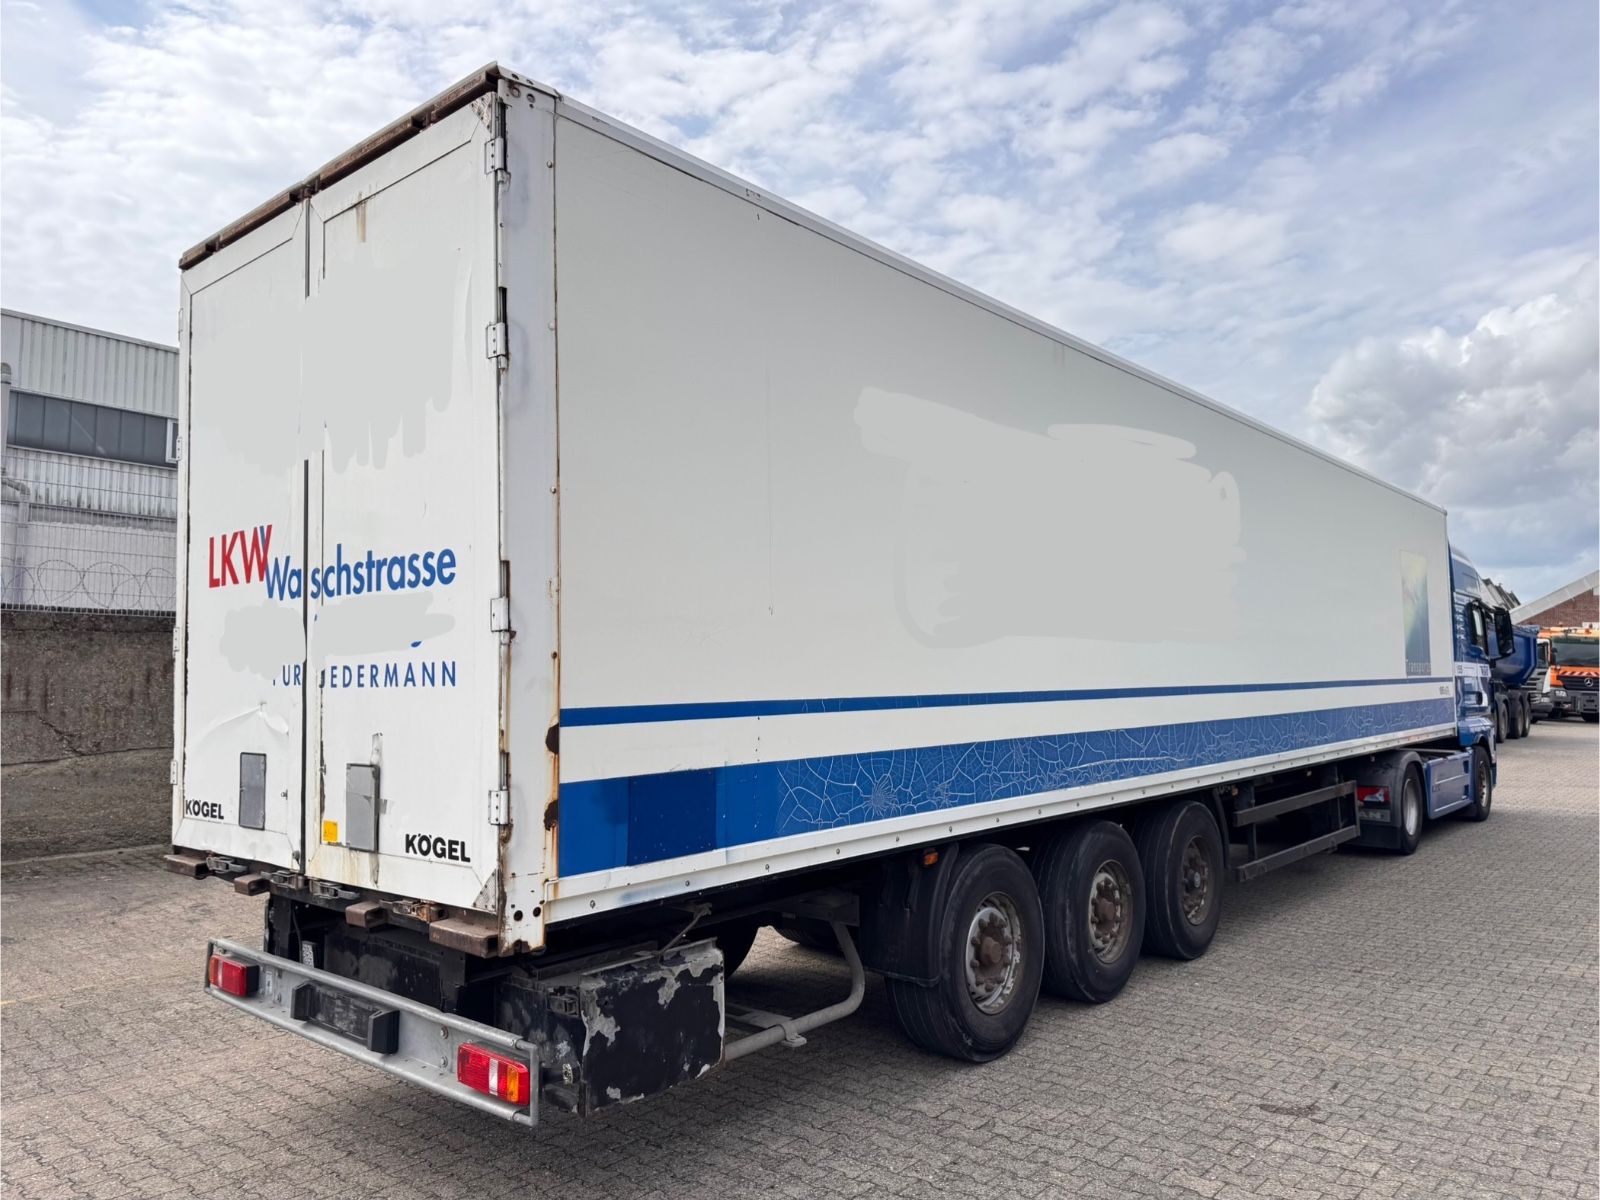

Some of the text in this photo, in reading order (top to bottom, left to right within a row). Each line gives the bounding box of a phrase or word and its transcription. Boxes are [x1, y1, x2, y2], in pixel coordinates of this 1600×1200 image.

[208, 524, 457, 601] LKW Waschstrasse
[318, 660, 457, 689] JEDERMANN
[185, 798, 225, 820] KÖGEL
[1359, 809, 1381, 819] AN
[405, 833, 471, 863] KÖGEL
